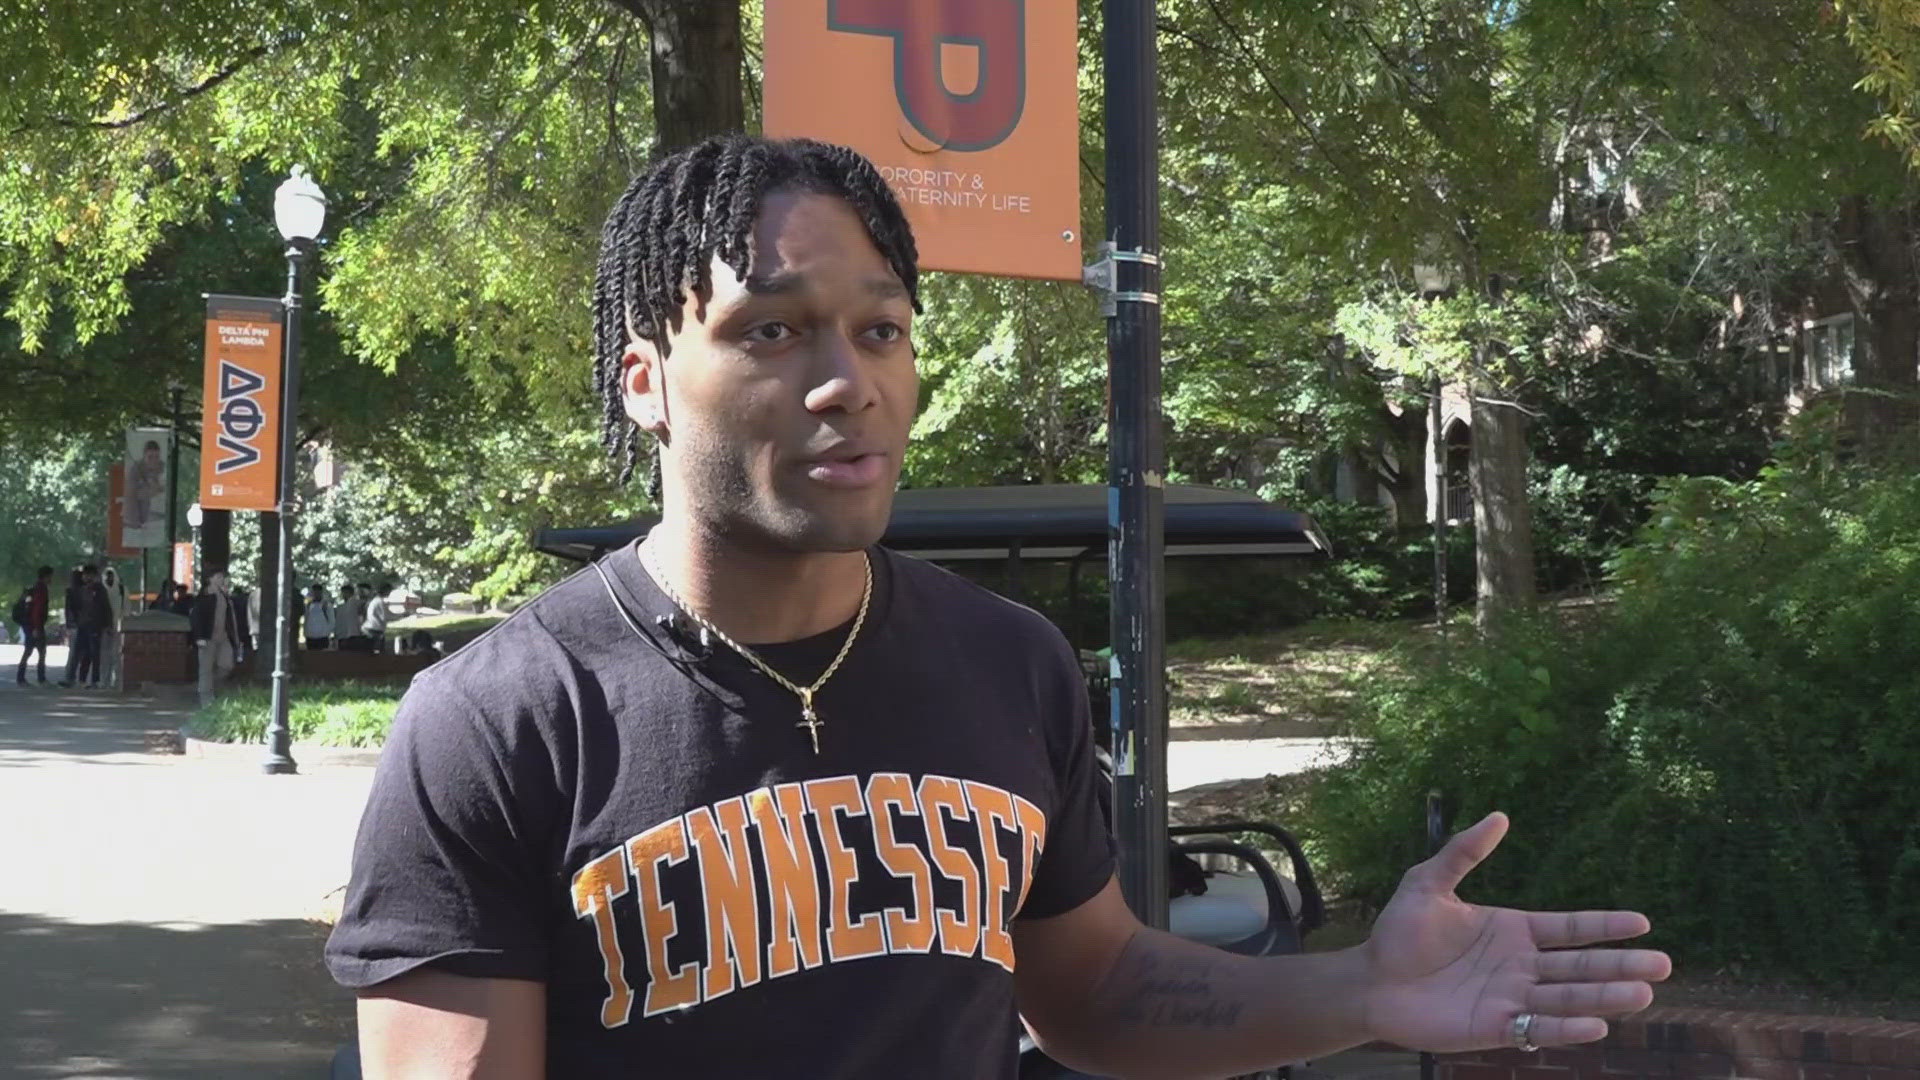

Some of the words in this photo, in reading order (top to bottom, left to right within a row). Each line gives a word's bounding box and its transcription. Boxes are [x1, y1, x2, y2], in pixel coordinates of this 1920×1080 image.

[880, 166, 966, 188] ORORITY
[971, 174, 984, 190] &
[894, 187, 987, 208] ATERNITY
[992, 195, 1031, 213] LIFE
[218, 326, 250, 336] DELTA
[252, 328, 270, 337] PHI
[222, 336, 265, 346] LAMBDA
